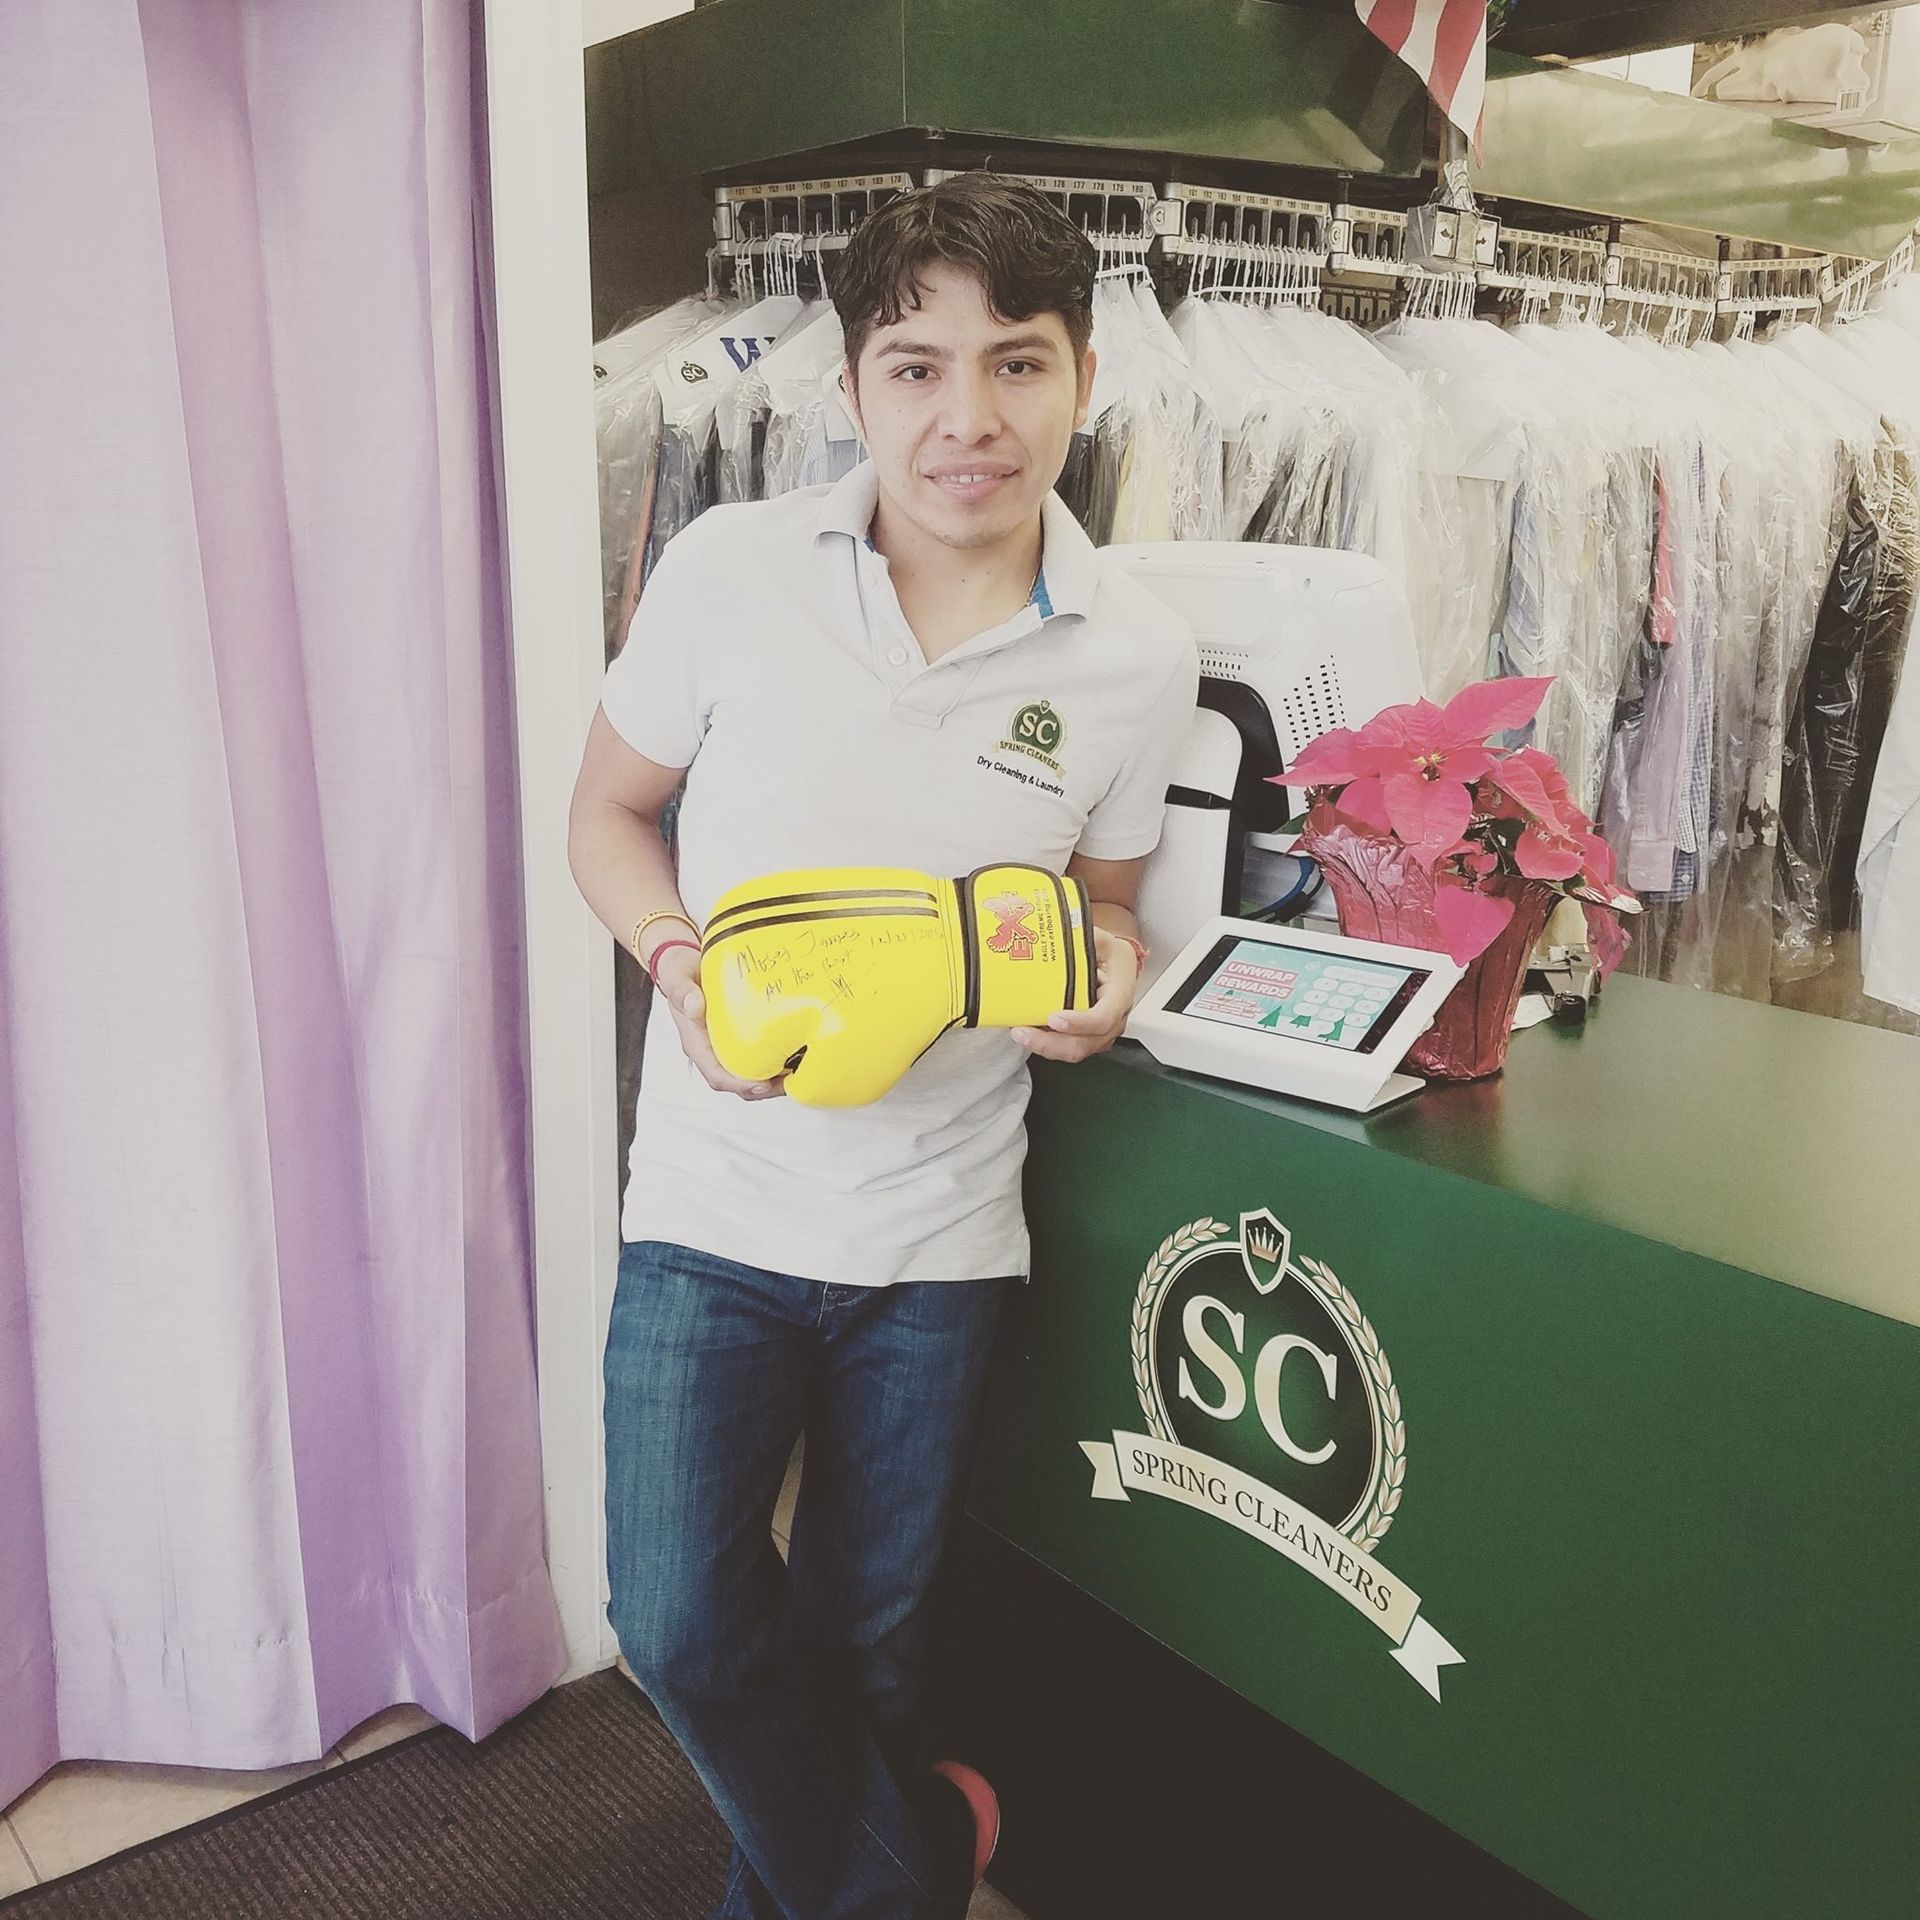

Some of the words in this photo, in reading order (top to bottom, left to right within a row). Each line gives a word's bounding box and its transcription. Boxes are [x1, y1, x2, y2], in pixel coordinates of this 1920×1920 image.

[1034, 179, 1046, 187] 175
[1053, 180, 1065, 188] 176
[1073, 181, 1085, 189] 177
[1093, 182, 1105, 190] 178
[1112, 183, 1124, 192] 179
[1132, 185, 1144, 193] 180
[1019, 712, 1058, 745] SC
[999, 740, 1027, 754] SPRING
[1026, 748, 1060, 771] CLEANERS
[977, 755, 993, 770] Dry
[993, 761, 1028, 784] Cleaning
[1035, 777, 1065, 798] Laundry
[792, 966, 815, 987] the
[1214, 976, 1292, 998] REWARDS
[1227, 962, 1296, 982] UNWRAP
[1178, 1294, 1338, 1465] SC
[1132, 1448, 1228, 1506] SPRING
[1235, 1490, 1393, 1613] CLEANERS
